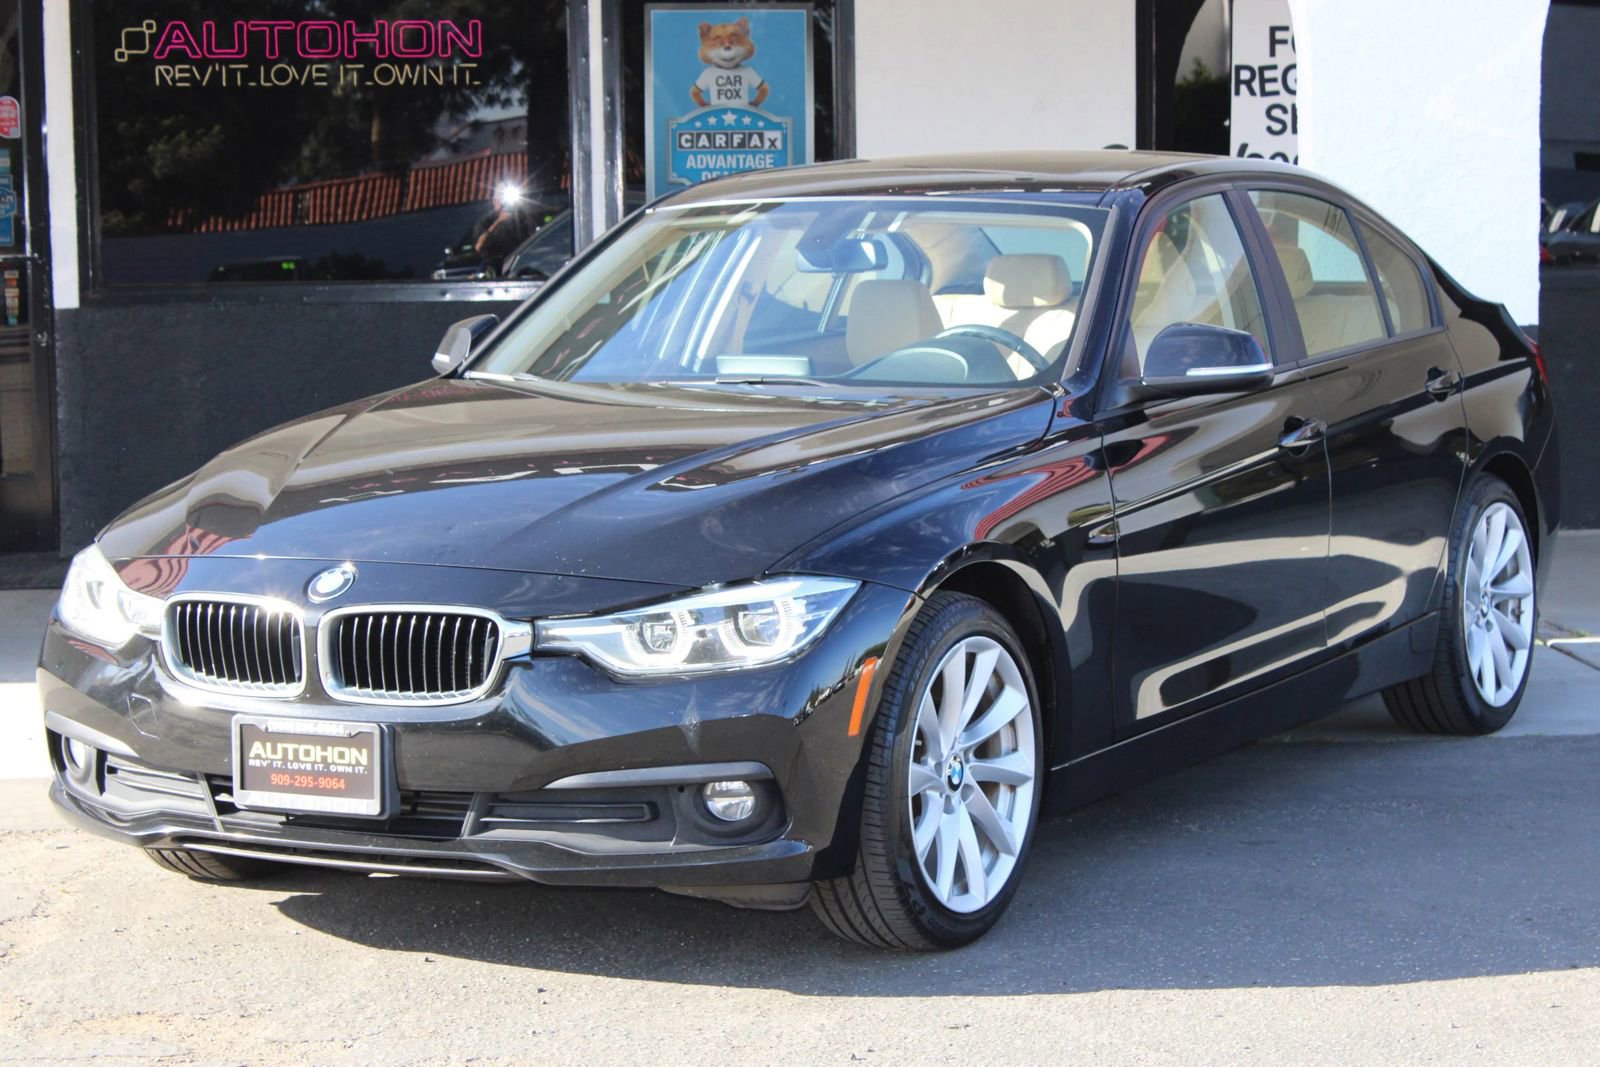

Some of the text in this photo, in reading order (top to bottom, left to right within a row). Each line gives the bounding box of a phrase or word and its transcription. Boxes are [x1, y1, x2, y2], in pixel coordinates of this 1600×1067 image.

[153, 20, 483, 59] AUTOHON
[1269, 25, 1296, 58] F
[715, 75, 743, 88] CAR
[717, 88, 742, 100] FOX
[1265, 103, 1298, 136] S
[686, 153, 775, 169] ADVANTAGE
[249, 741, 368, 765] AUTOHON
[273, 760, 285, 769] IT.
[287, 762, 312, 770] LOVE
[314, 763, 327, 772] IT.
[329, 764, 353, 773] OWN
[354, 766, 368, 774] IT.
[270, 773, 346, 790] 909-295-9064
